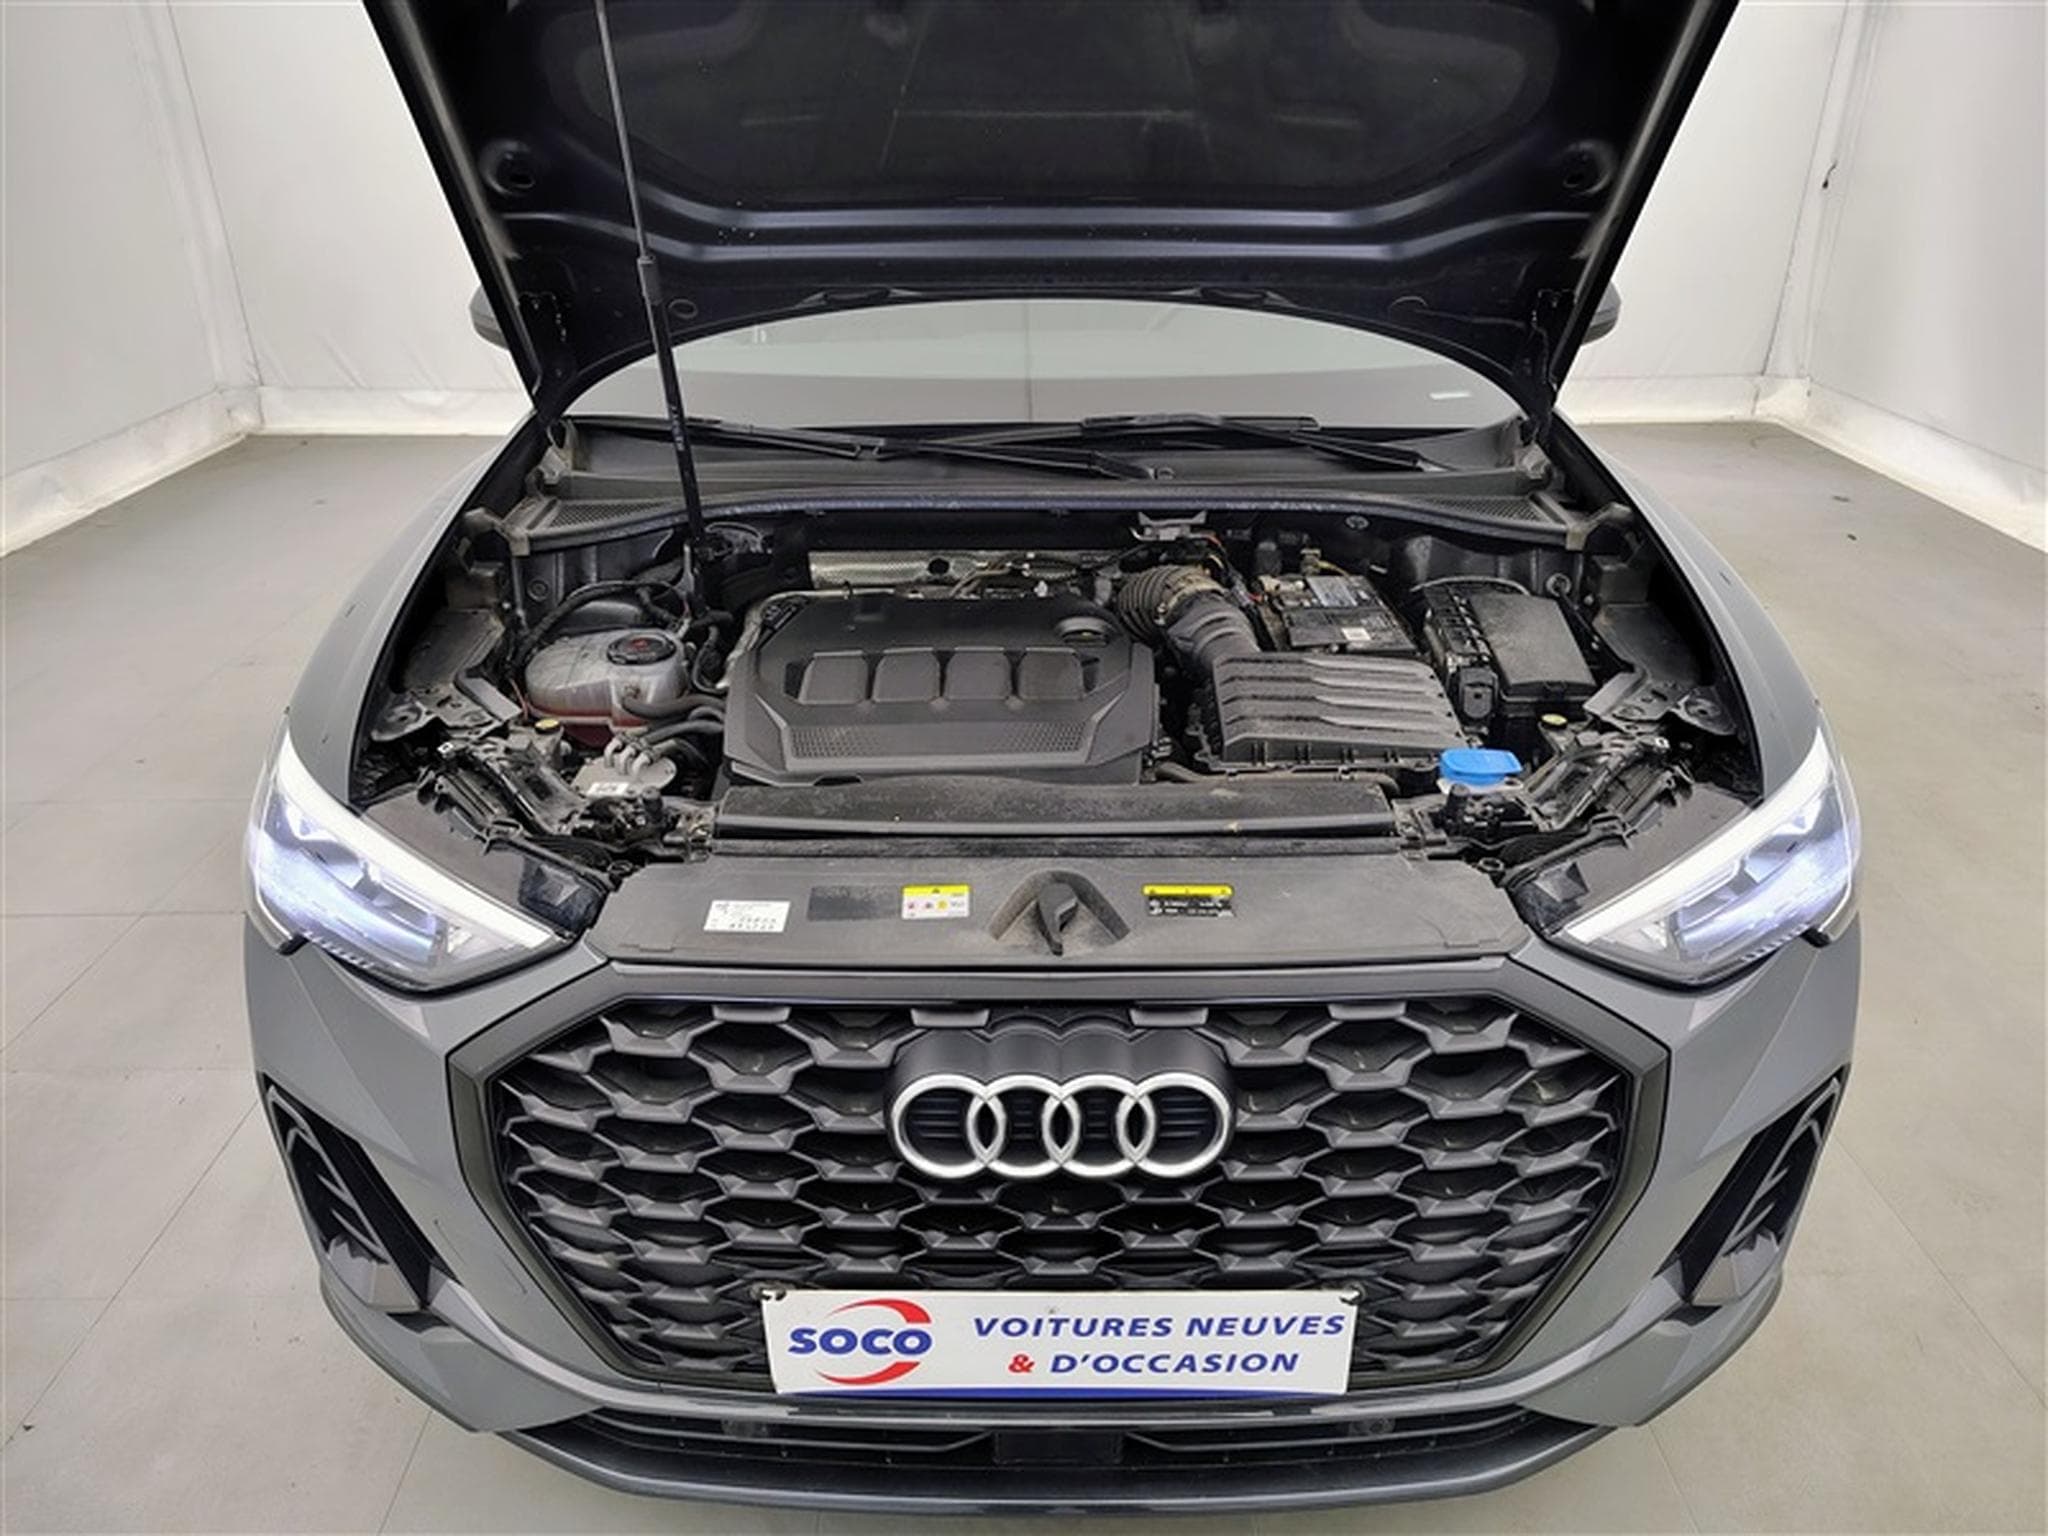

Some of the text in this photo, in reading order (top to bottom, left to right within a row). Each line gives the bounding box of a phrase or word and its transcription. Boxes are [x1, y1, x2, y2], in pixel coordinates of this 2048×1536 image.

[974, 1314, 1345, 1338] VOITURES NEUVES
[788, 1327, 933, 1356] SOCO
[1008, 1352, 1298, 1374] & D'OCCASION
